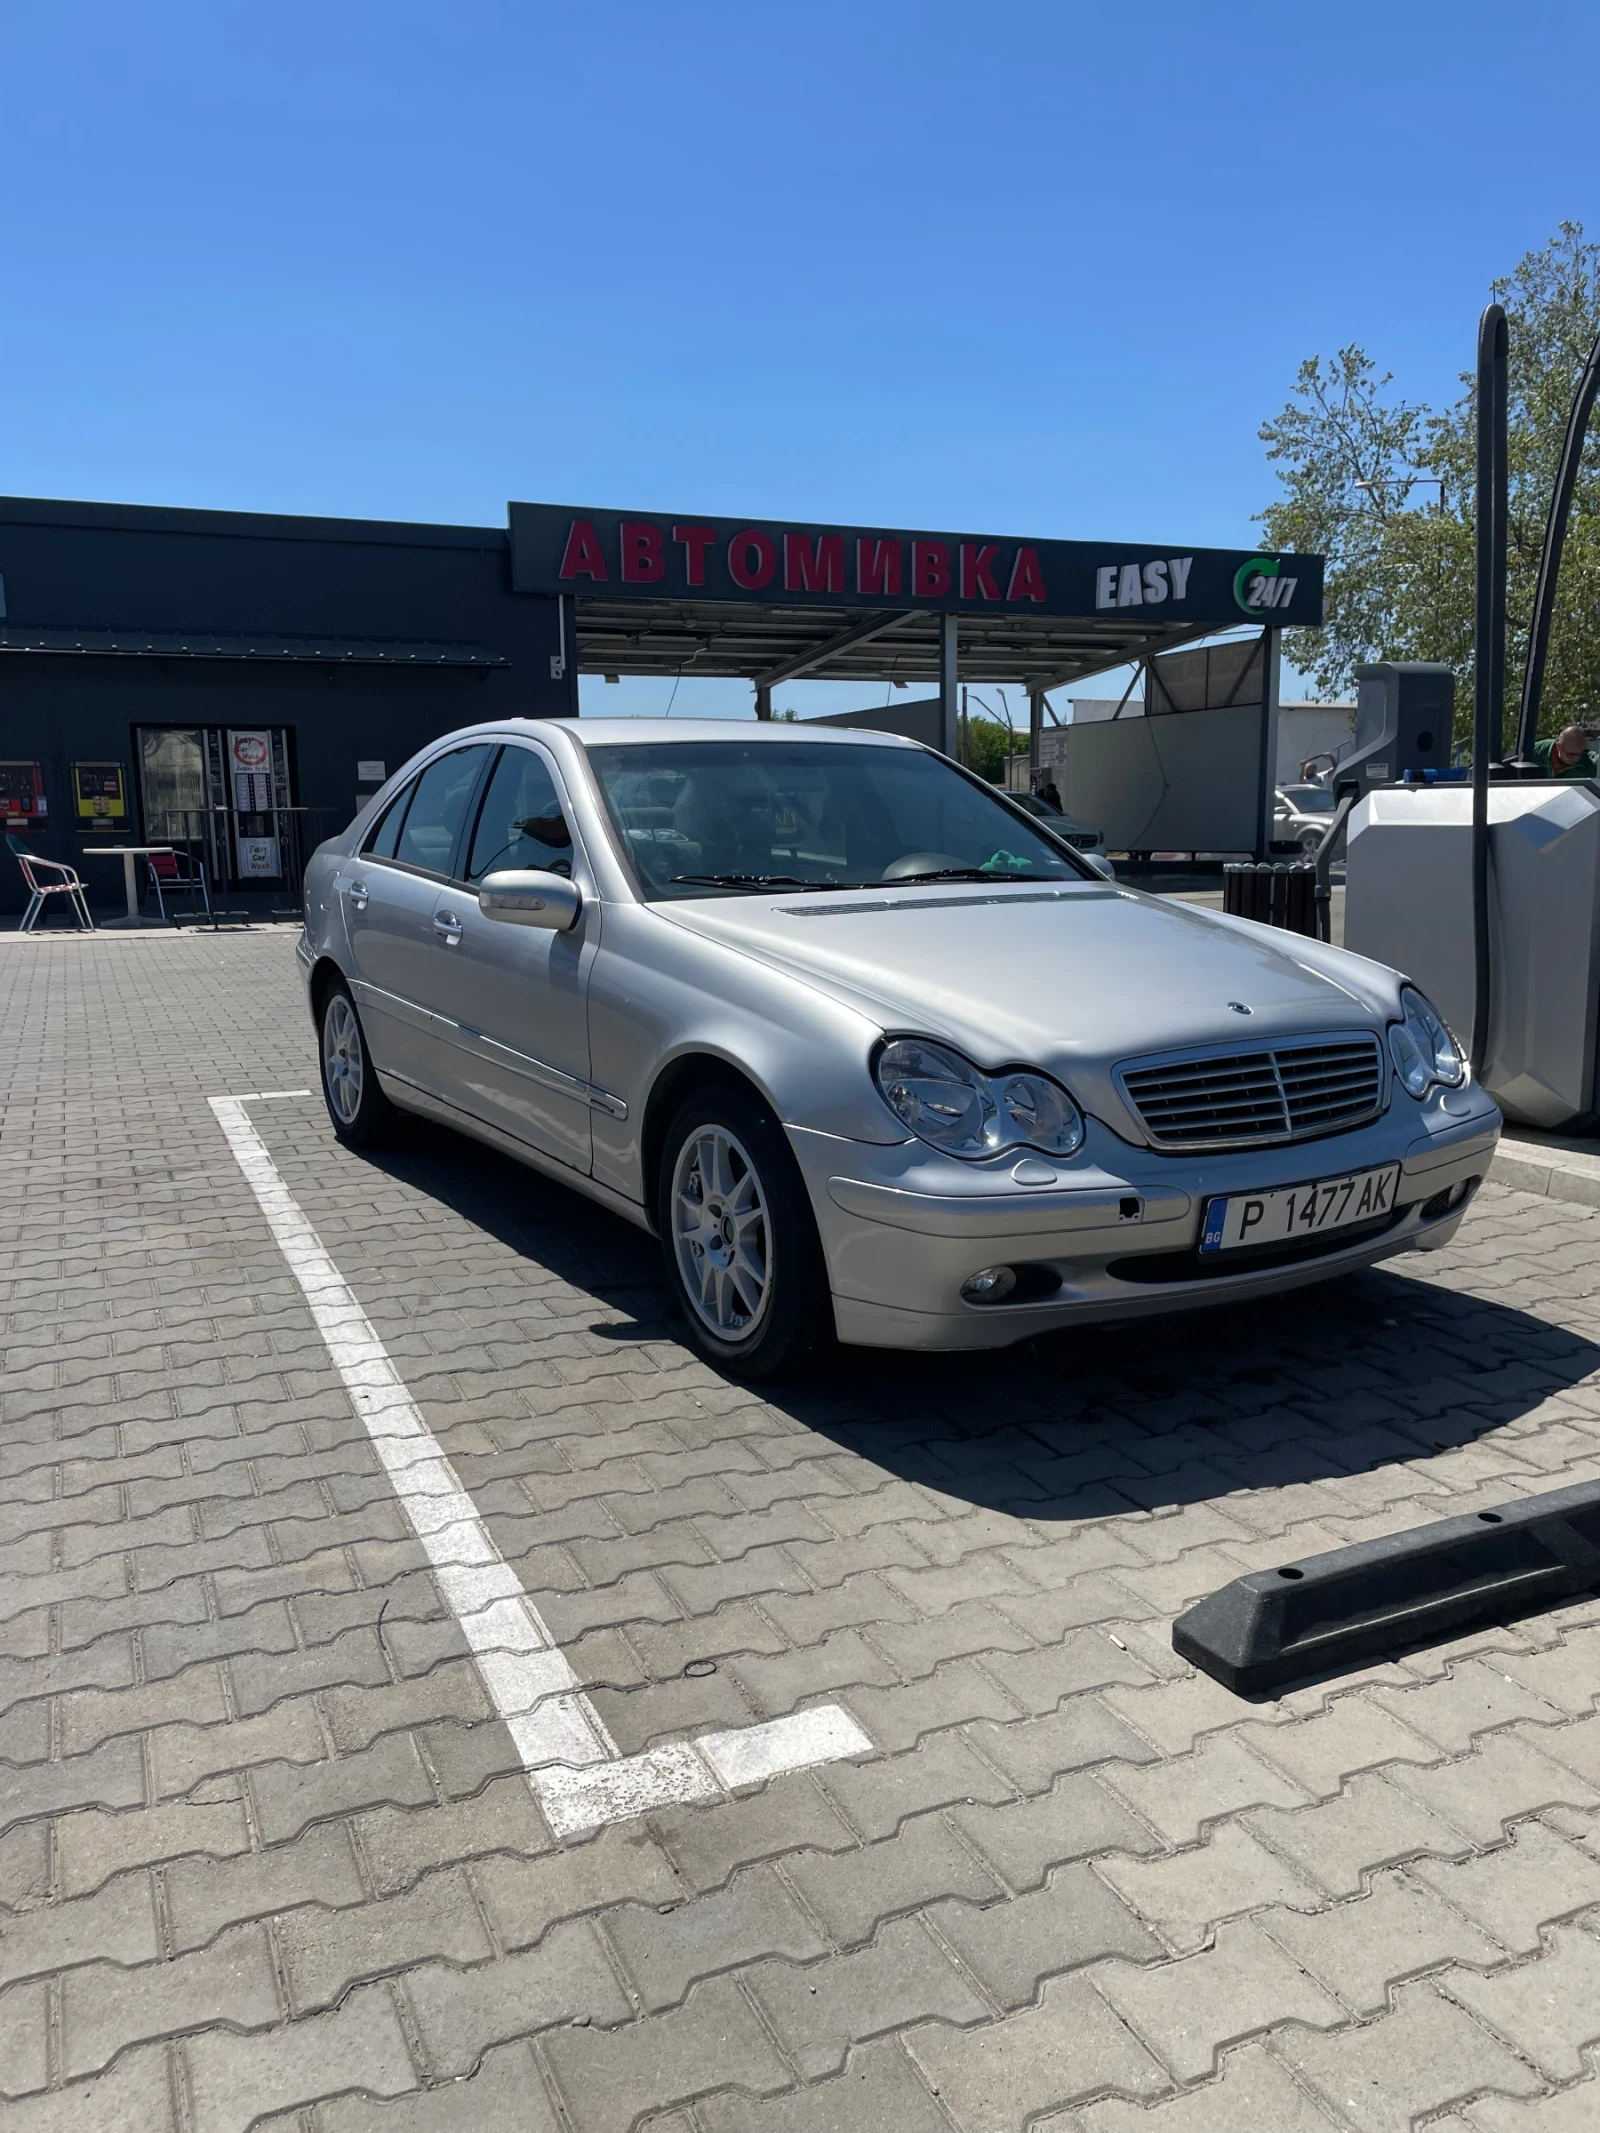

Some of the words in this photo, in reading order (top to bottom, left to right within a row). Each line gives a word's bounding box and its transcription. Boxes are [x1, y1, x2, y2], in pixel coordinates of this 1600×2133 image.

[559, 520, 1047, 602] АВТОМИВКА
[1096, 557, 1193, 610] EASY
[1247, 575, 1298, 608] 24/7
[251, 862, 270, 870] Wash
[1238, 1200, 1265, 1241] P
[1286, 1182, 1355, 1232] 1477
[1355, 1171, 1393, 1217] AK
[1205, 1231, 1221, 1244] BG
